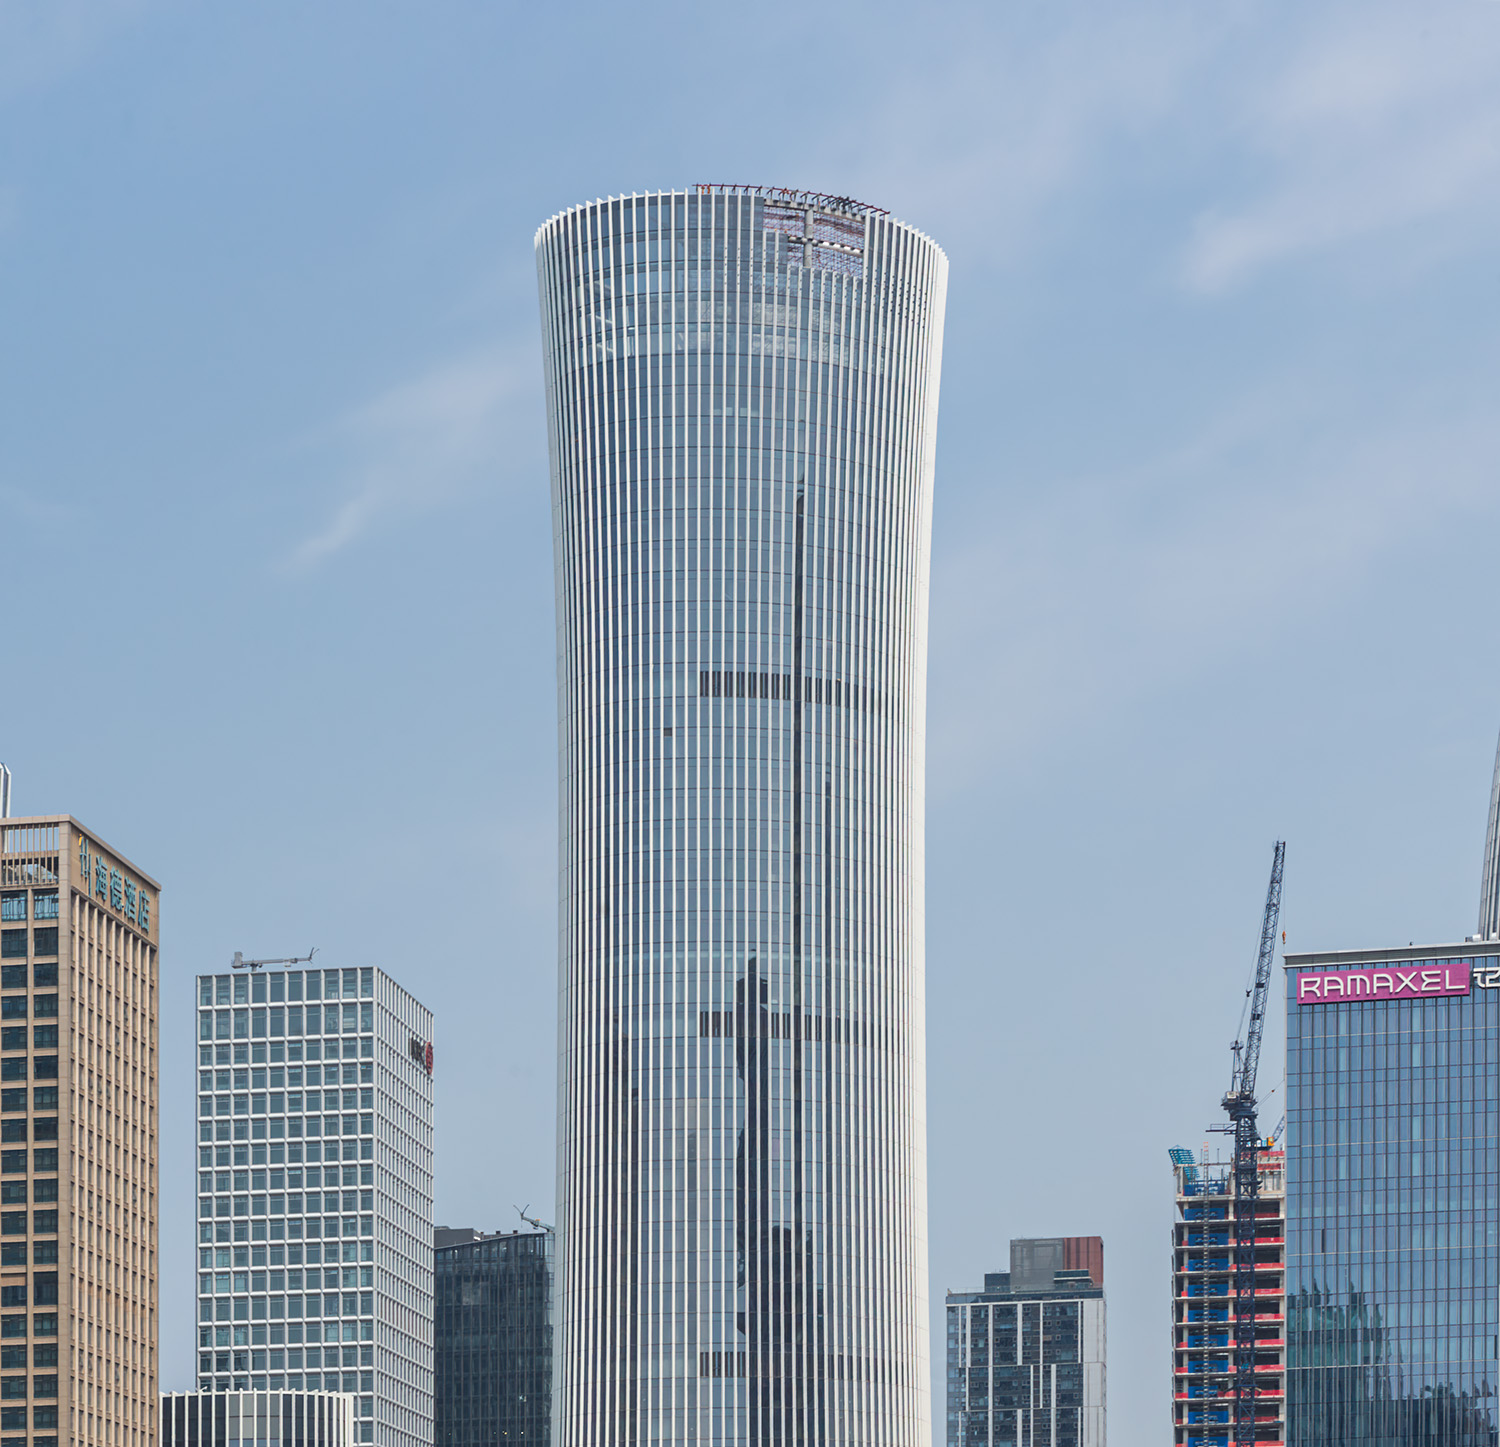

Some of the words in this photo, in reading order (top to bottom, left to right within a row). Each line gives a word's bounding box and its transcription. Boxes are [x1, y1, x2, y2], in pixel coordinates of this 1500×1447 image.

[95, 855, 151, 933] 海德酒店
[1300, 969, 1466, 998] RAMAXEL
